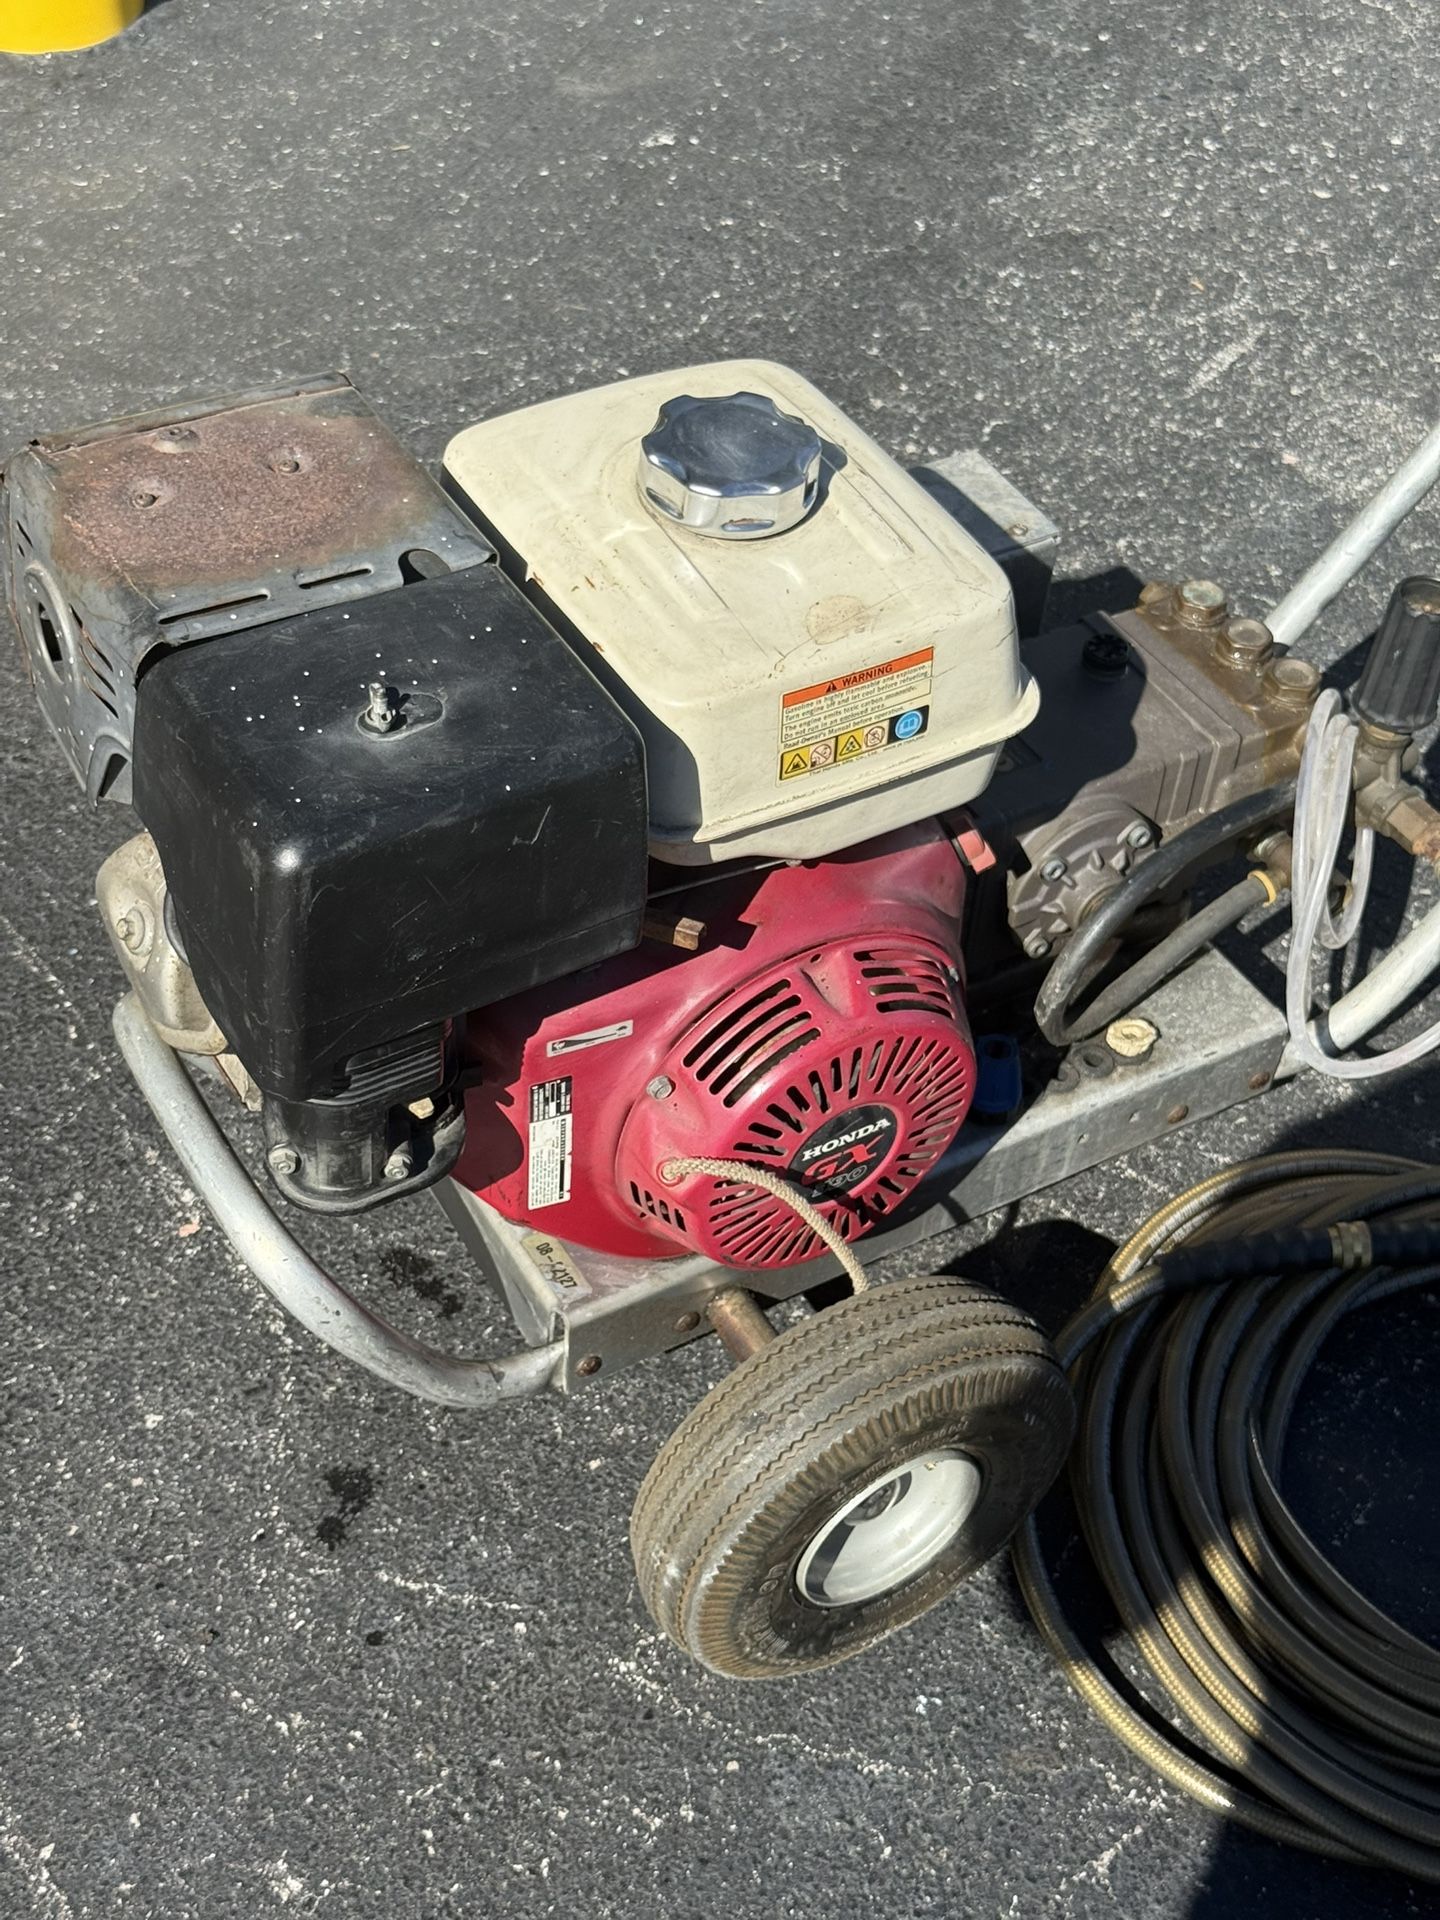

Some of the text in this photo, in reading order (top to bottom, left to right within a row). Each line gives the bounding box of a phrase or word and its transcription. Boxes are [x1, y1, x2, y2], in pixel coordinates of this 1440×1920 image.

[842, 663, 892, 687] WARNING
[784, 712, 799, 722] Turn
[801, 705, 823, 718] engine
[837, 696, 849, 705] and
[851, 692, 859, 700] let
[861, 687, 875, 696] cool
[876, 680, 897, 691] before
[784, 723, 796, 732] The
[798, 716, 821, 729] engine
[823, 709, 841, 719] emits
[843, 703, 859, 713] toxic
[860, 695, 883, 707] carbon
[783, 739, 799, 749] Read
[827, 722, 850, 735] Manual
[852, 715, 872, 726] before
[784, 731, 792, 739] Do
[807, 724, 818, 732] run
[802, 1118, 890, 1161] HONDA
[805, 1135, 884, 1181] GX
